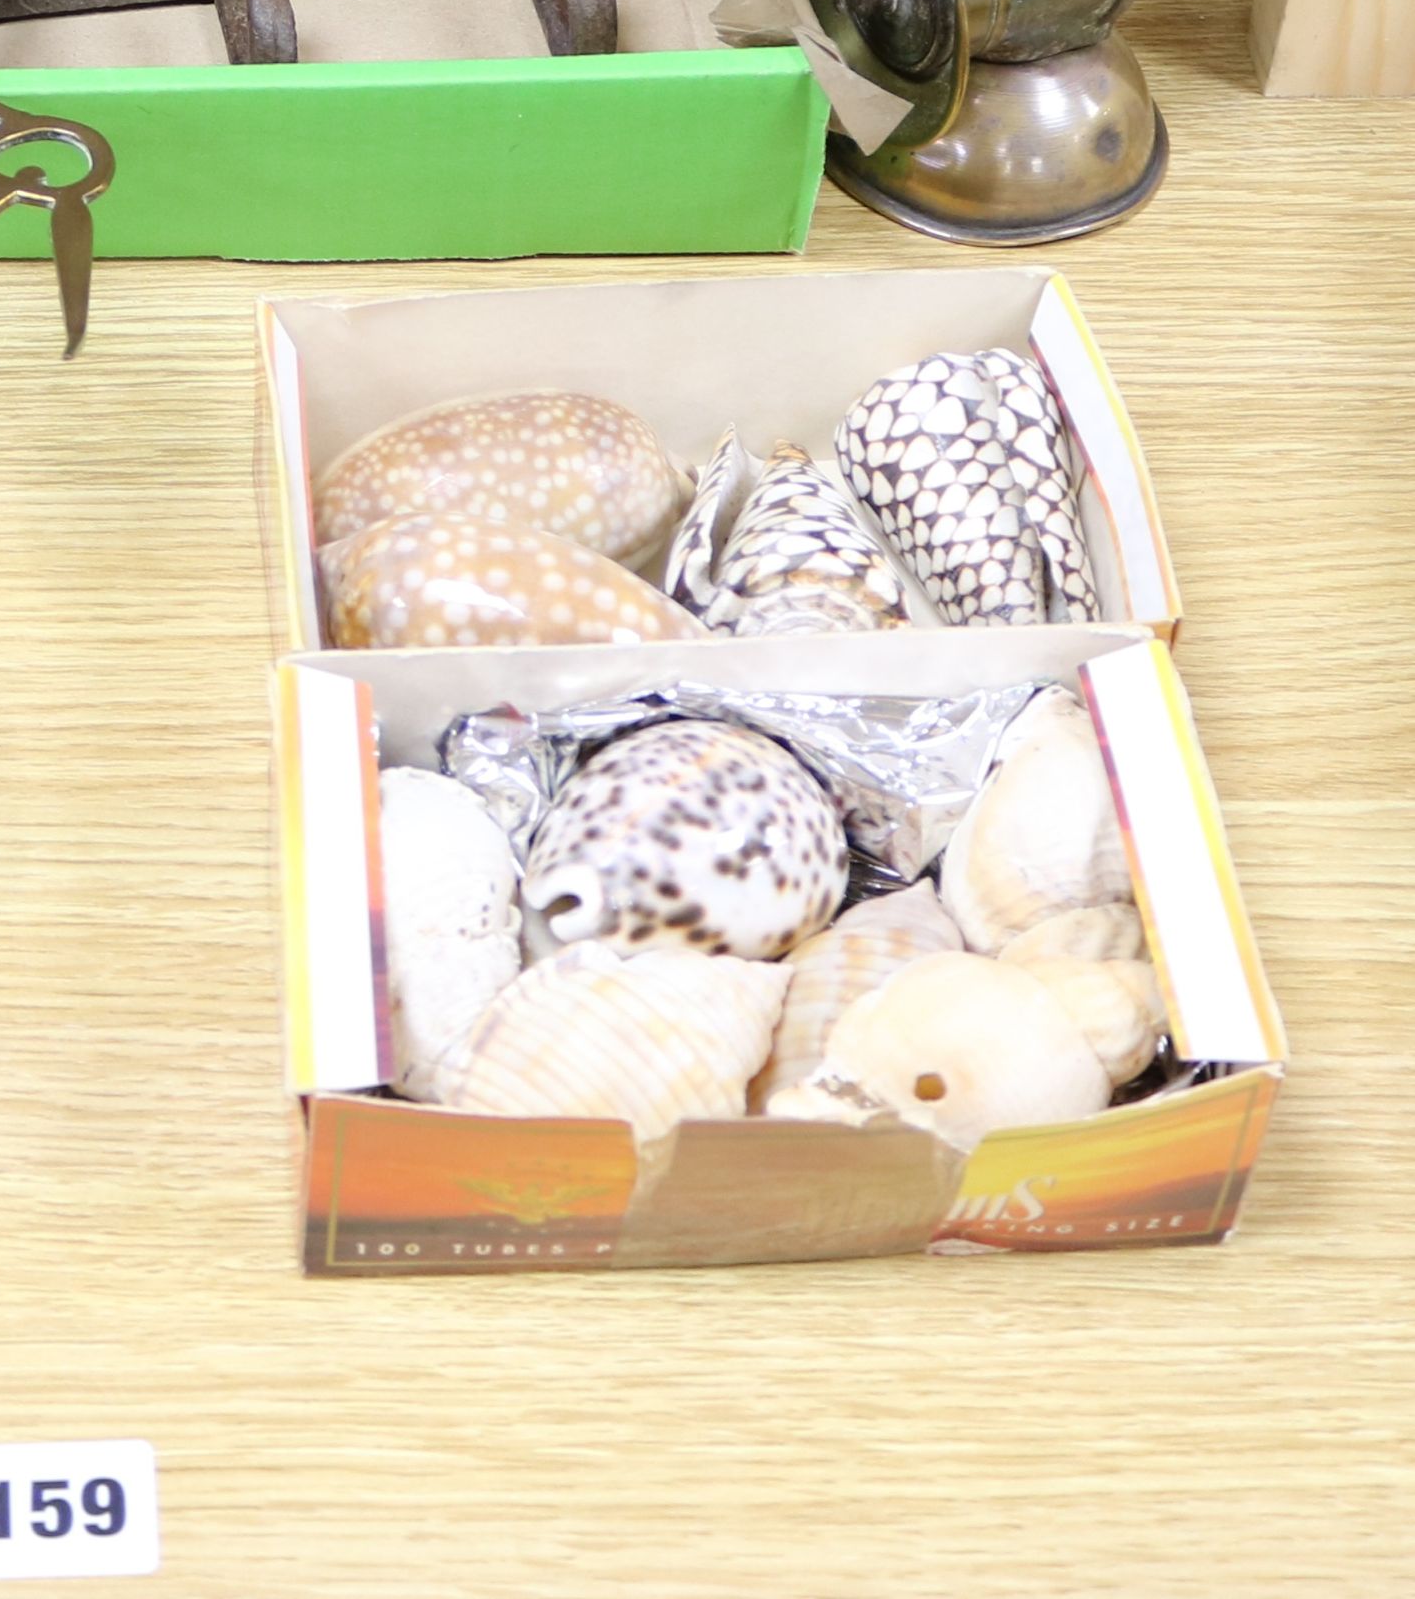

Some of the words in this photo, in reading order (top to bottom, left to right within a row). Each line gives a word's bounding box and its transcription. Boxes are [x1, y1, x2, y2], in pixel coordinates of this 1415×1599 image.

[354, 1242, 421, 1255] 100
[452, 1242, 565, 1255] TUBES
[1105, 1213, 1185, 1232] SIZE
